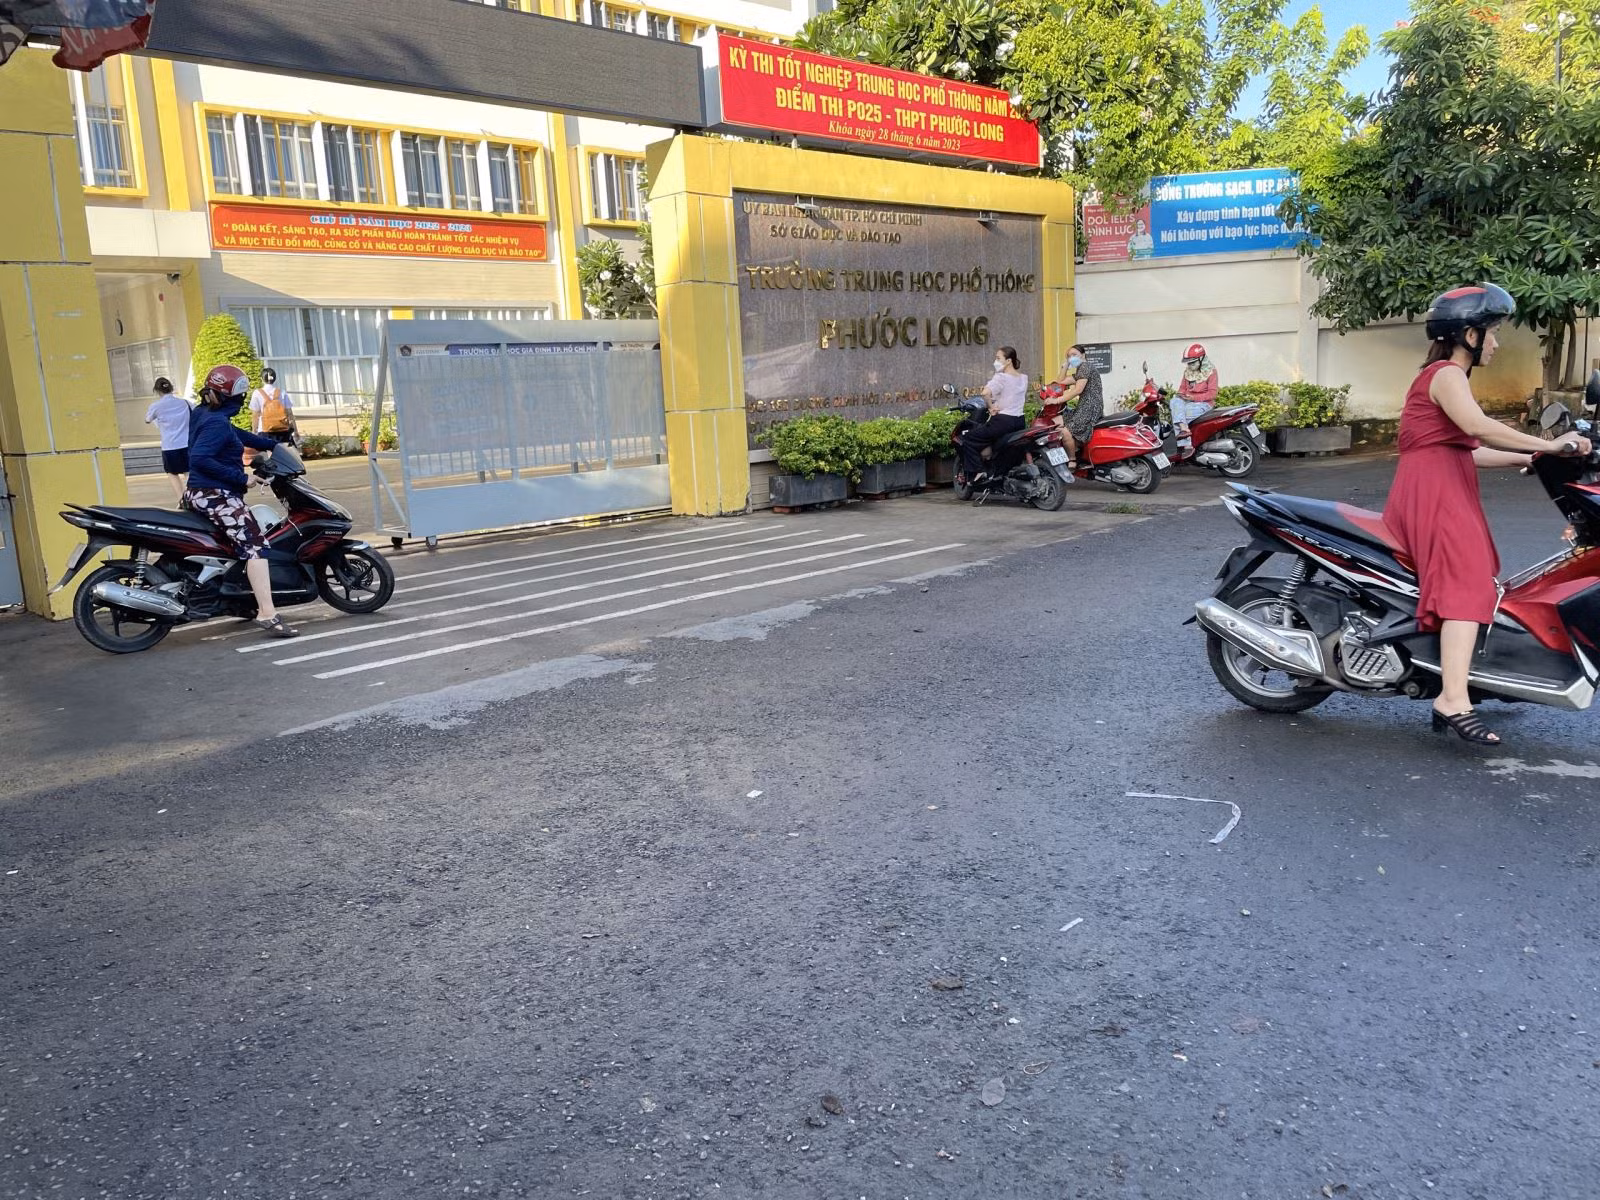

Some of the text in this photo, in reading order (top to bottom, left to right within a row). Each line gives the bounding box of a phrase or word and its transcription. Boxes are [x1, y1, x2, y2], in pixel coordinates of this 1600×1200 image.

[729, 44, 747, 70] KỲ
[751, 51, 774, 75] THI
[777, 51, 801, 80] TỐT
[805, 62, 852, 91] NGHIỆP
[856, 72, 894, 97] TRUNG
[898, 80, 920, 104] HỌC
[924, 82, 946, 106] PHỔ
[948, 89, 981, 113] THÔNG
[984, 95, 1007, 117] NĂM
[776, 83, 816, 112] ĐIỂM
[820, 95, 843, 117] THI
[894, 108, 926, 130] THPT
[930, 114, 970, 137] PHƯỚC
[974, 121, 1004, 142] LONG
[829, 120, 961, 151] Khóa ngày 28 tháng 6 năm 2023
[1184, 180, 1223, 199] TRƯỜNG
[358, 215, 384, 227] NĂM
[762, 203, 786, 217] BAN
[879, 210, 896, 224] CHÍ
[897, 212, 922, 226] MINH
[1088, 213, 1135, 225] DOL IELTS
[1177, 210, 1194, 224] Xây
[1196, 209, 1220, 224] dựng
[1221, 206, 1240, 220] tình
[1242, 206, 1260, 220] bạn
[1261, 203, 1275, 217] tốt
[259, 222, 281, 235] KẾT,
[282, 224, 306, 235] SÁNG
[330, 227, 341, 236] RA
[344, 226, 360, 237] SỨC
[362, 226, 384, 238] PHẤN
[386, 228, 402, 239] ĐẤU
[404, 229, 425, 240] HOÀN
[427, 231, 452, 242] THÀNH
[453, 232, 468, 243] TỐT
[470, 234, 484, 244] CÁC
[486, 235, 508, 245] NHIỆM
[510, 237, 519, 246] VỤ
[770, 222, 901, 246] SỞ GIÁO DỤC VÀ ĐÀO TẠO
[1161, 229, 1176, 243] Nói
[1178, 228, 1207, 242] không
[1209, 225, 1223, 239] với
[1225, 225, 1243, 240] bạo
[1245, 224, 1259, 239] lực
[1261, 222, 1279, 238] học
[224, 234, 236, 245] VÀ
[240, 236, 259, 247] MỤC
[263, 236, 282, 247] TIÊU
[285, 235, 301, 247] ĐỔI
[349, 238, 360, 249] CỐ
[362, 239, 373, 250] VÀ
[375, 240, 397, 251] NÂNG
[399, 243, 414, 252] CAO
[416, 242, 435, 252] CHẤT
[438, 245, 462, 255] LƯỢNG
[464, 246, 480, 255] GIÁO
[482, 247, 496, 256] DỤC
[498, 247, 508, 256] VÀ
[510, 248, 524, 256] ĐÀO
[746, 260, 1036, 297] TRƯỜNG TRUNG HỌC PHỔ THÔNG
[818, 306, 989, 350] PHƯỚC LONG
[458, 346, 489, 356] TRƯỜNG
[521, 347, 534, 355] GIA
